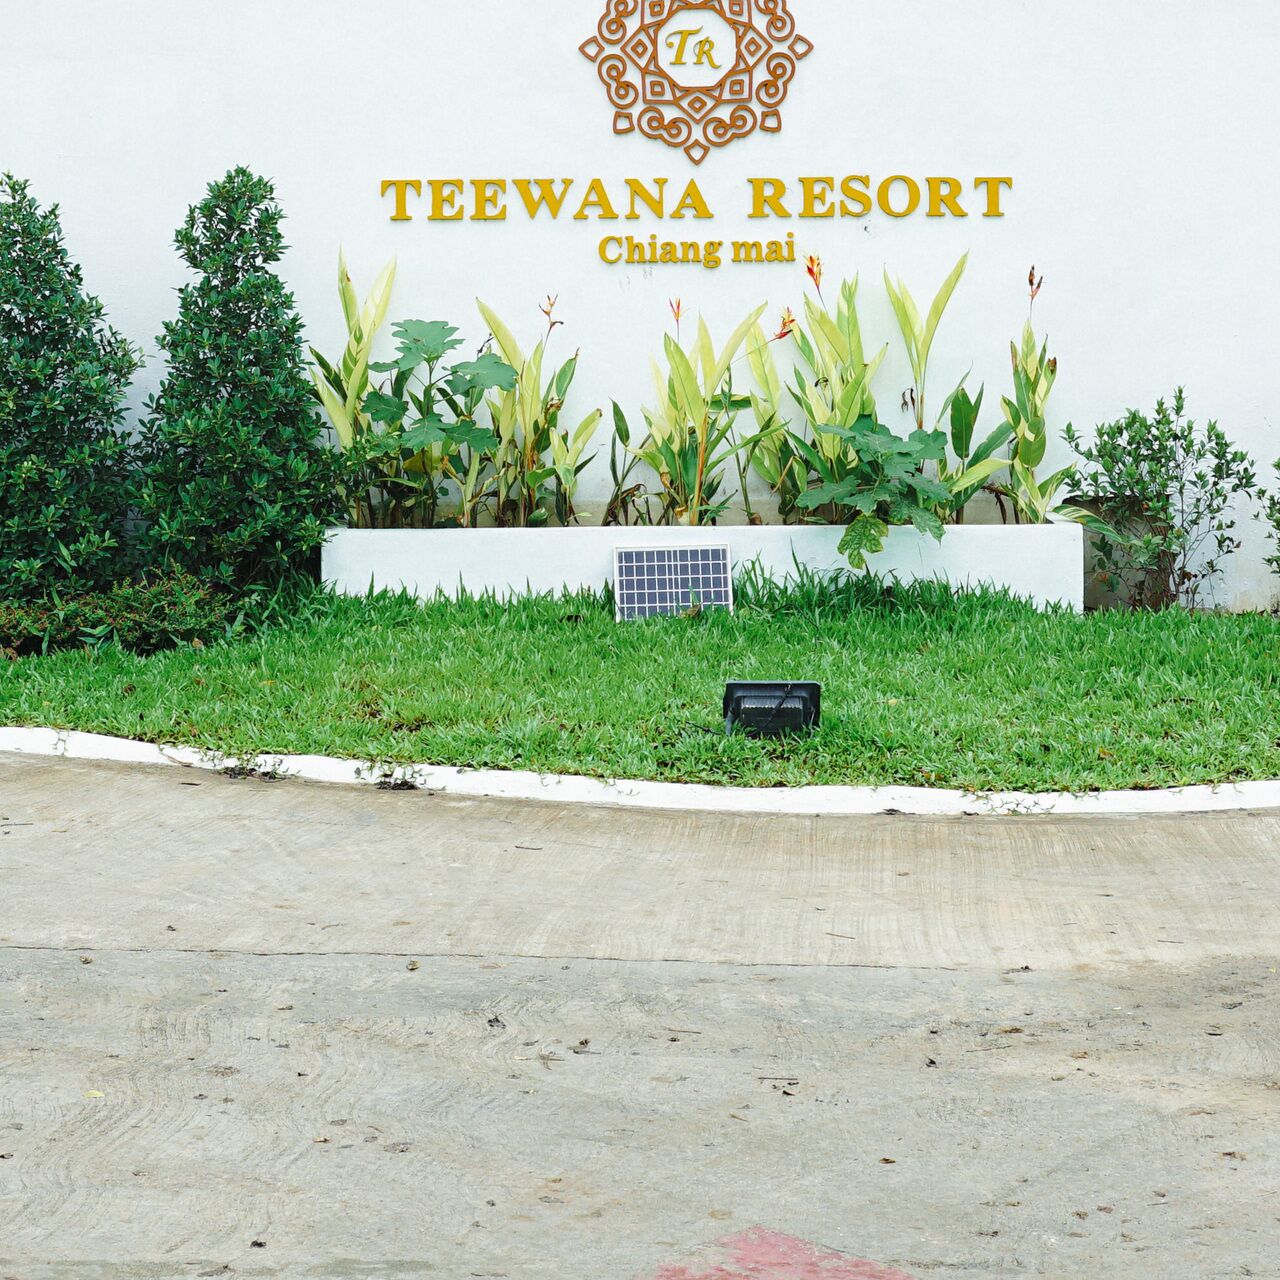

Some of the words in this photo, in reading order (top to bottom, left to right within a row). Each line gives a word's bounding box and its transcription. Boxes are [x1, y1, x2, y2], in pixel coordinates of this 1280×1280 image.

[380, 177, 715, 222] TEEWANA
[746, 174, 1013, 220] RESORT
[598, 233, 723, 269] Chiang
[731, 231, 797, 264] mai
